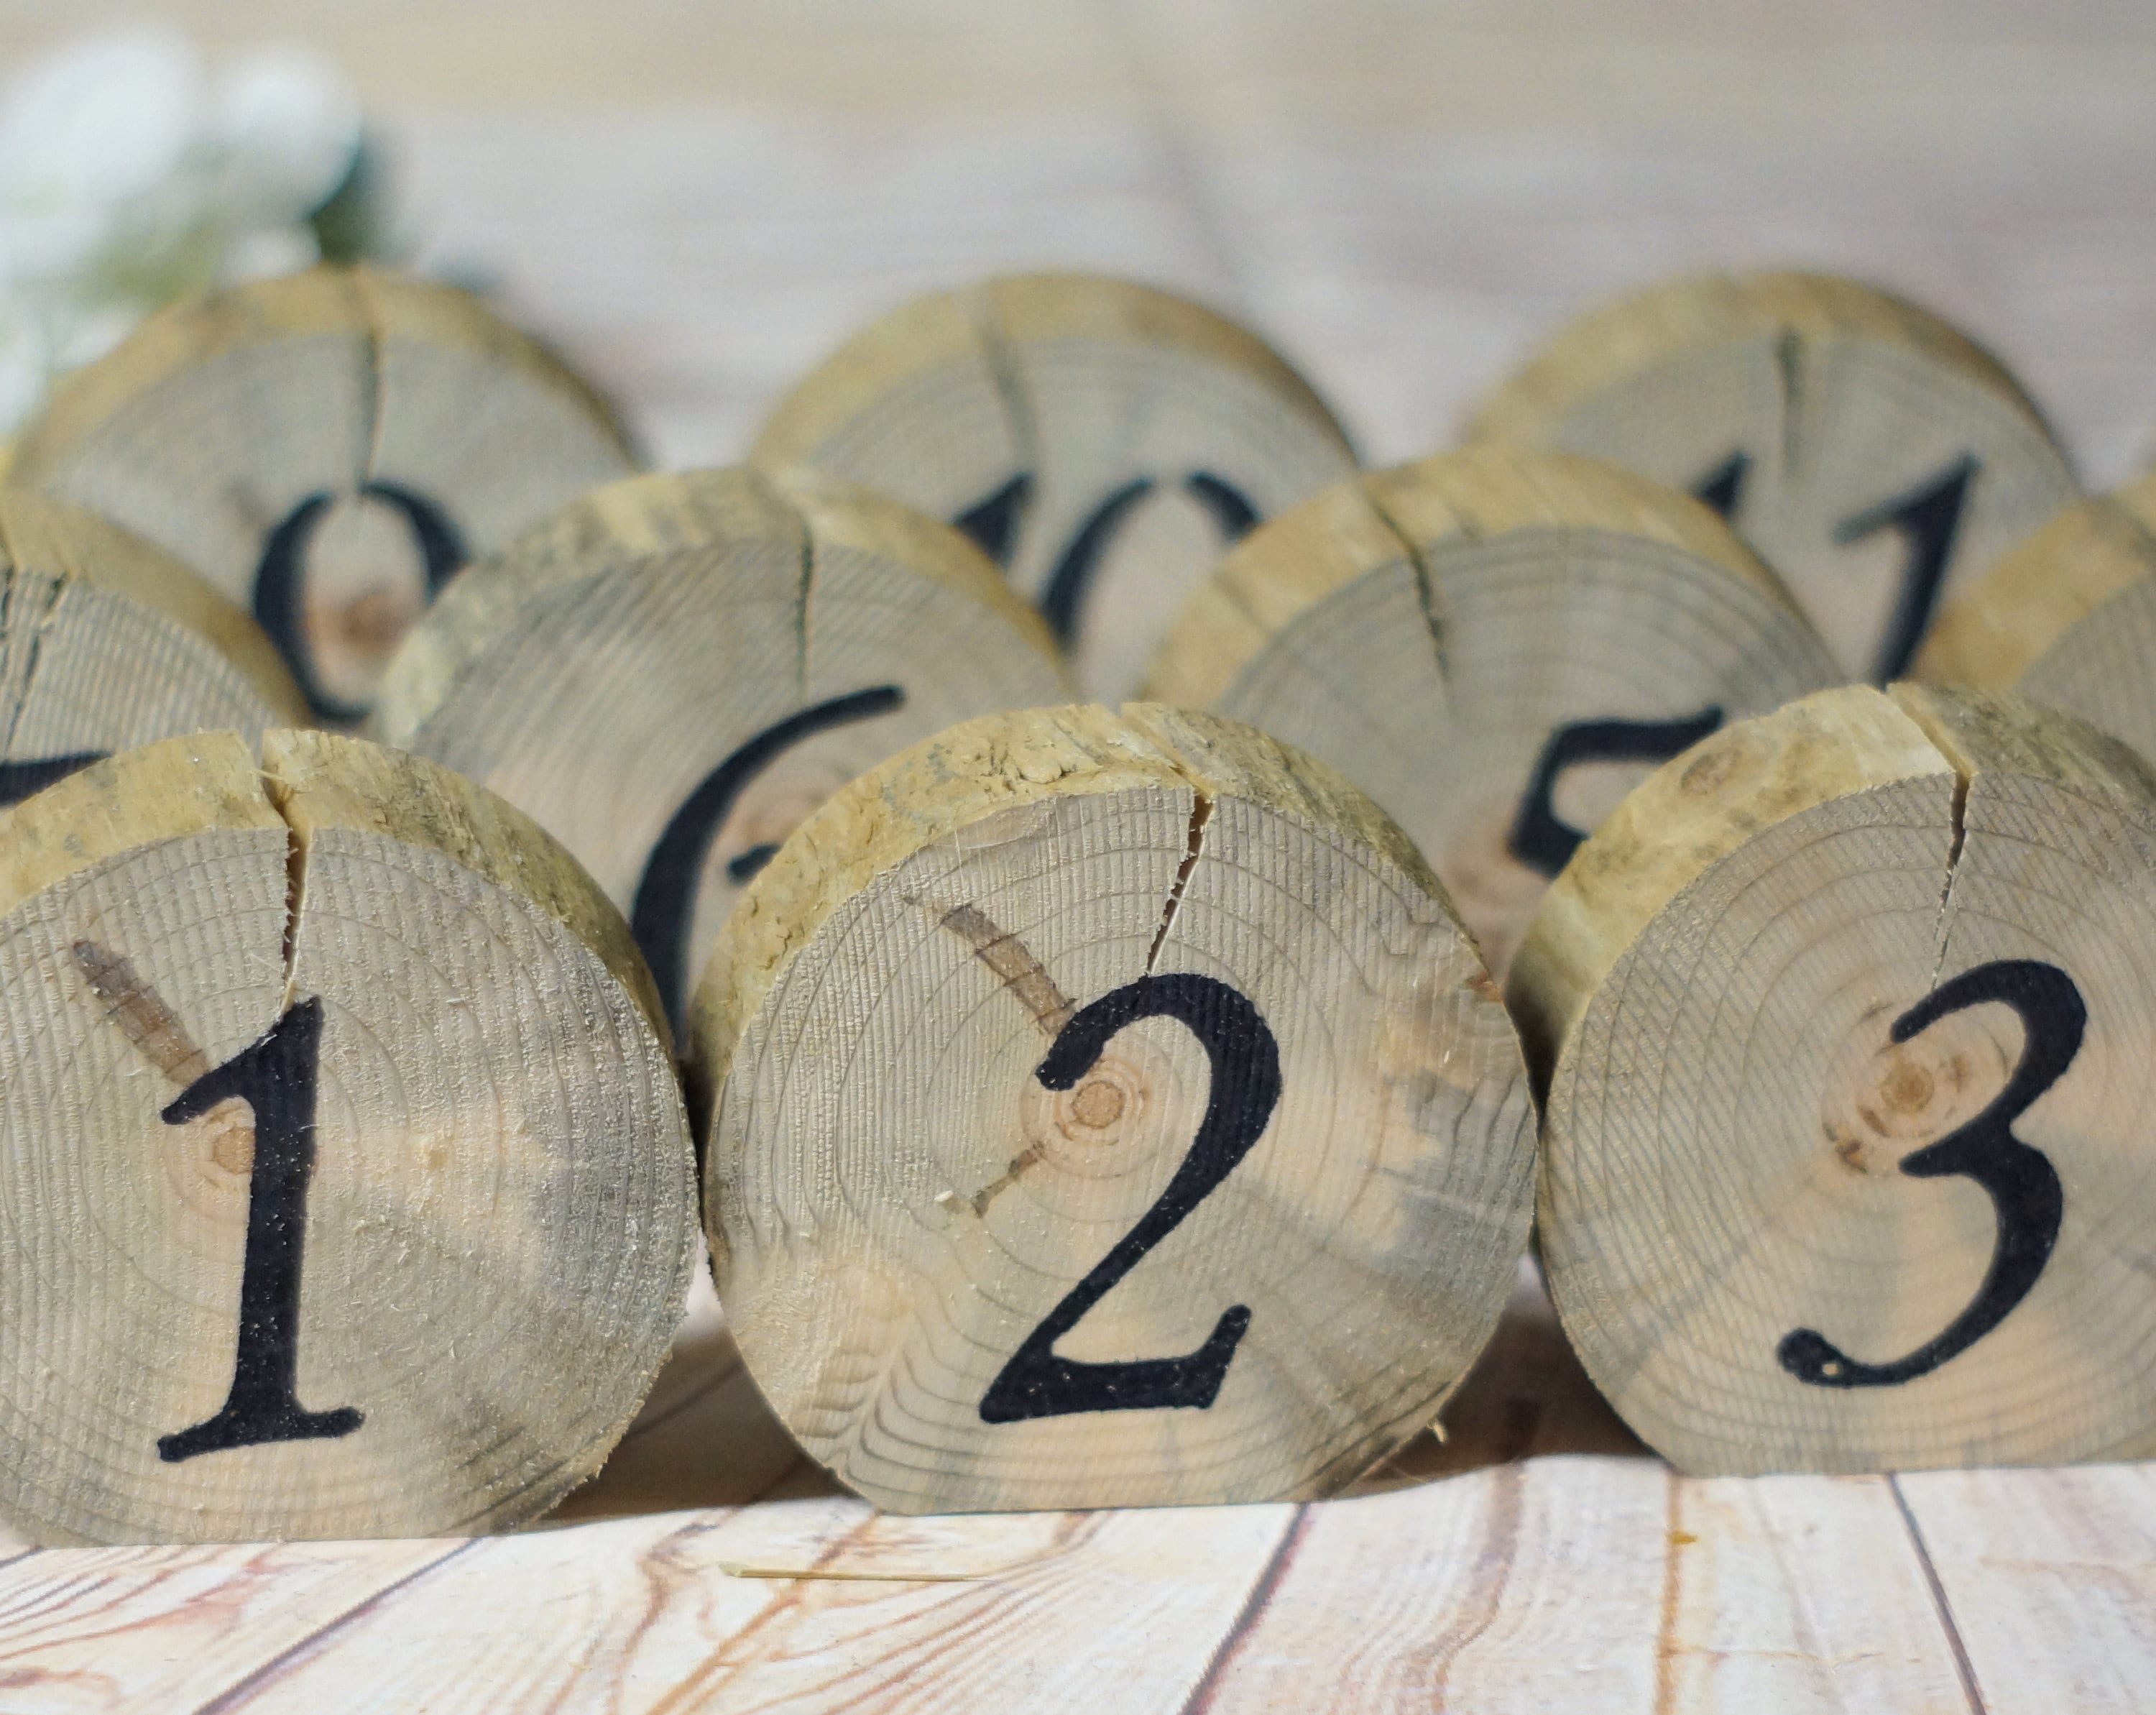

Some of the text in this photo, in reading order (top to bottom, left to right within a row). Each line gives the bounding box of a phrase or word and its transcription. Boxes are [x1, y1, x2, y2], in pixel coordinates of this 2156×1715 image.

[950, 471, 1263, 650] 0
[1692, 453, 1981, 690] 1
[157, 995, 365, 1463] 1
[979, 973, 1283, 1425] 2
[1776, 959, 2088, 1389] 3
